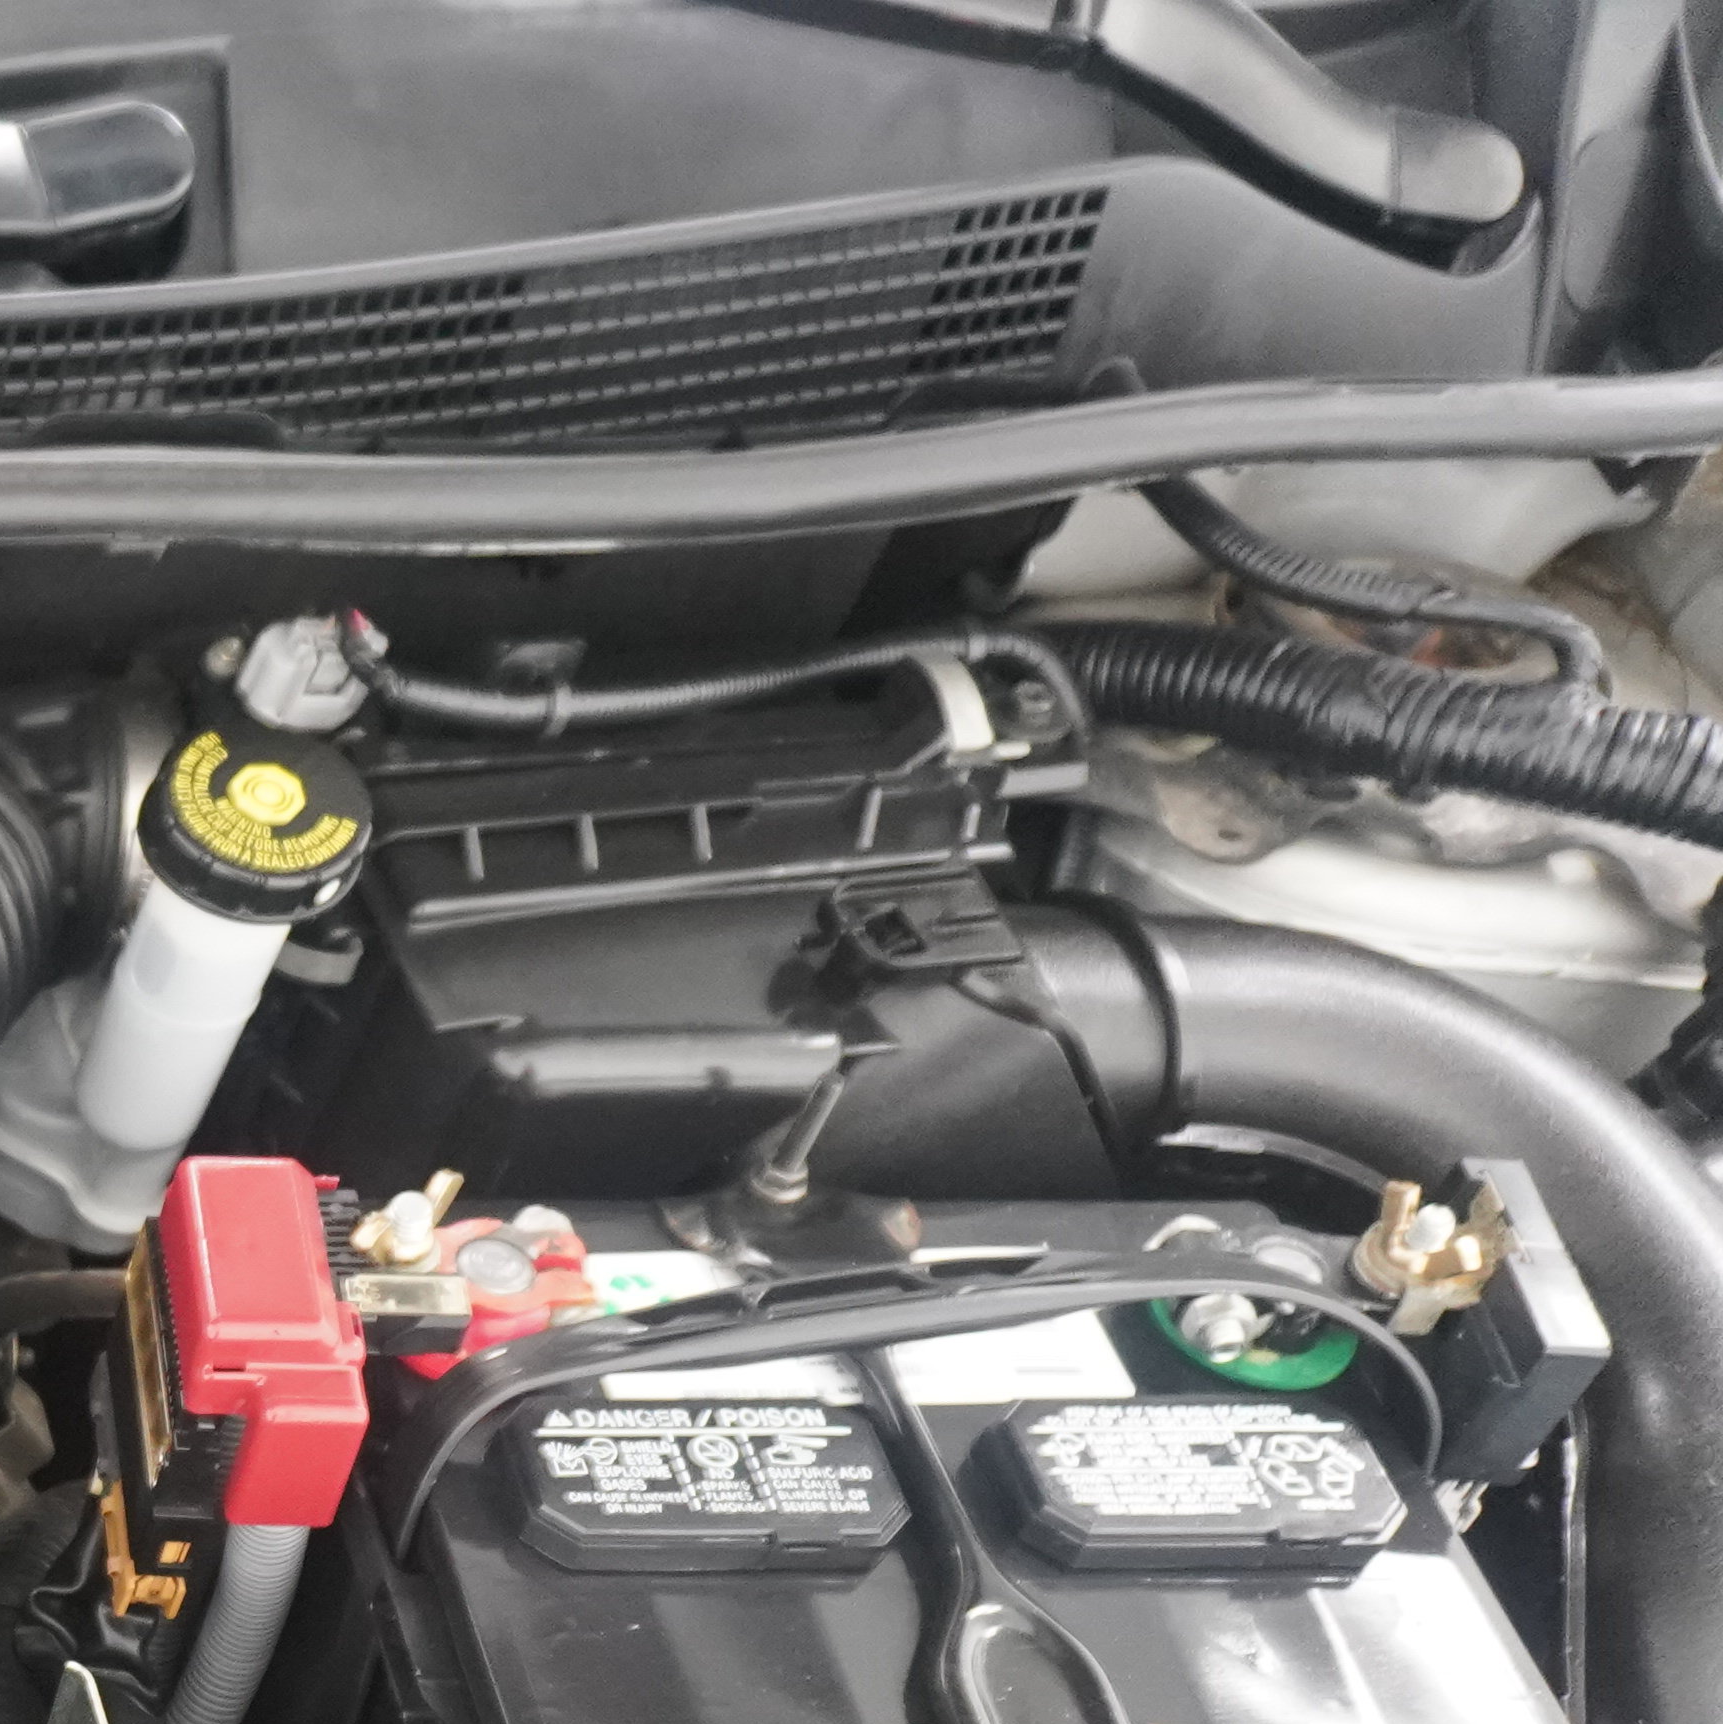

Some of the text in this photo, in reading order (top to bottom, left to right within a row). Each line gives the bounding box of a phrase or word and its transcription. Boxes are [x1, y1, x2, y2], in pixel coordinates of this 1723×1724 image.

[193, 776, 215, 813] FILLER
[206, 812, 233, 834] CAP
[228, 828, 282, 853] BEFORE
[282, 814, 339, 853] REMOVING
[215, 797, 273, 840] WARNING
[180, 801, 207, 834] FLUID
[205, 829, 243, 858] FROM
[241, 849, 252, 863] A
[254, 851, 305, 869] SEALED
[302, 817, 358, 865] CONTAINER
[573, 1408, 692, 1428] DANGER
[717, 1407, 827, 1428] POISON
[619, 1440, 671, 1453] SHIELD
[625, 1454, 662, 1466] EYES
[593, 1465, 673, 1479] EXPLOSIVE
[708, 1468, 735, 1479] NO
[766, 1467, 873, 1480] SULFURIC ACID
[599, 1479, 648, 1491] GASES
[772, 1480, 842, 1490] CAN CAUSE
[567, 1492, 593, 1503] CAN
[593, 1492, 629, 1504] CAUSE
[605, 1503, 624, 1515] OR
[783, 1501, 828, 1512] SEVERE
